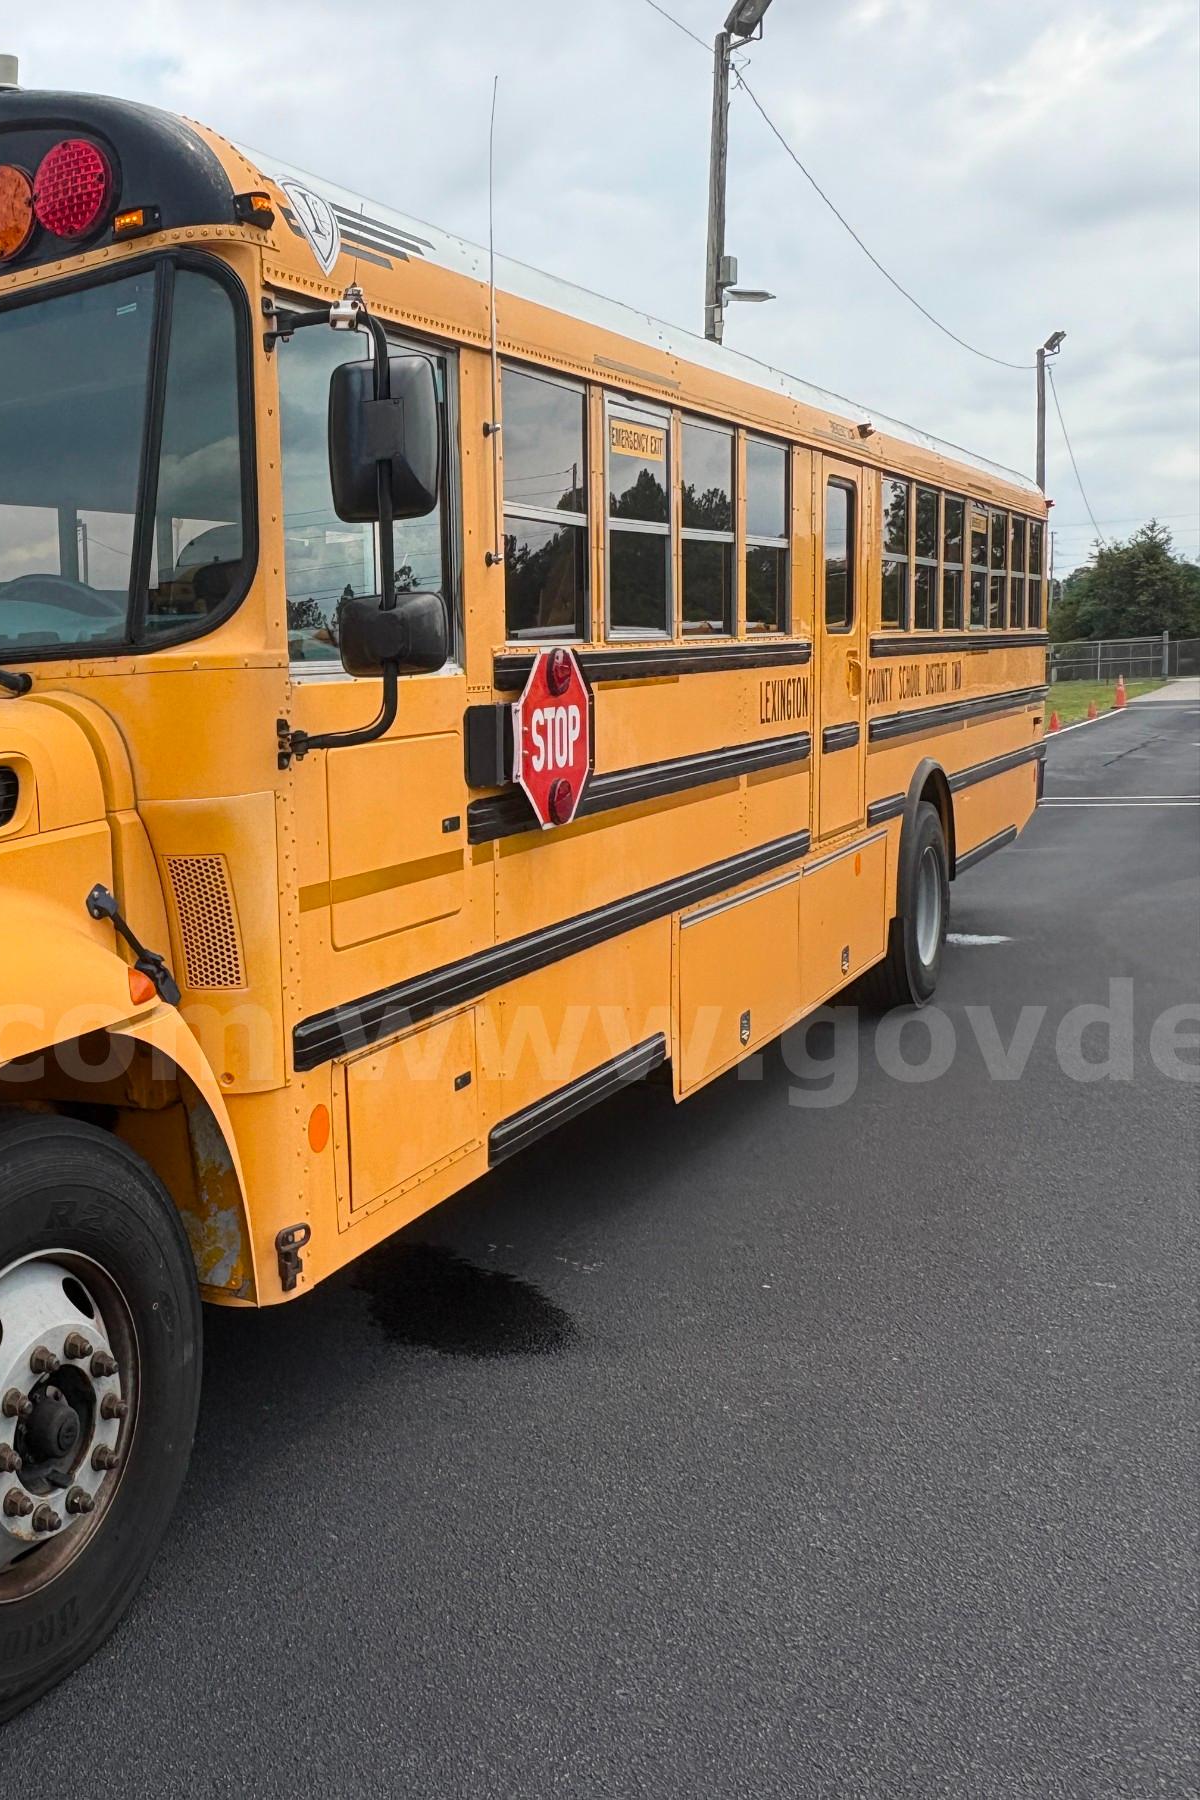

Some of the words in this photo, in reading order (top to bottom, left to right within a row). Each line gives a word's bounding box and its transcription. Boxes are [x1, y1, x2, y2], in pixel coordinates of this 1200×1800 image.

[611, 426, 649, 453] EMERGENCY
[760, 676, 809, 724] LEXINGTON
[867, 667, 893, 705] COUNTY
[531, 704, 581, 772] STOP
